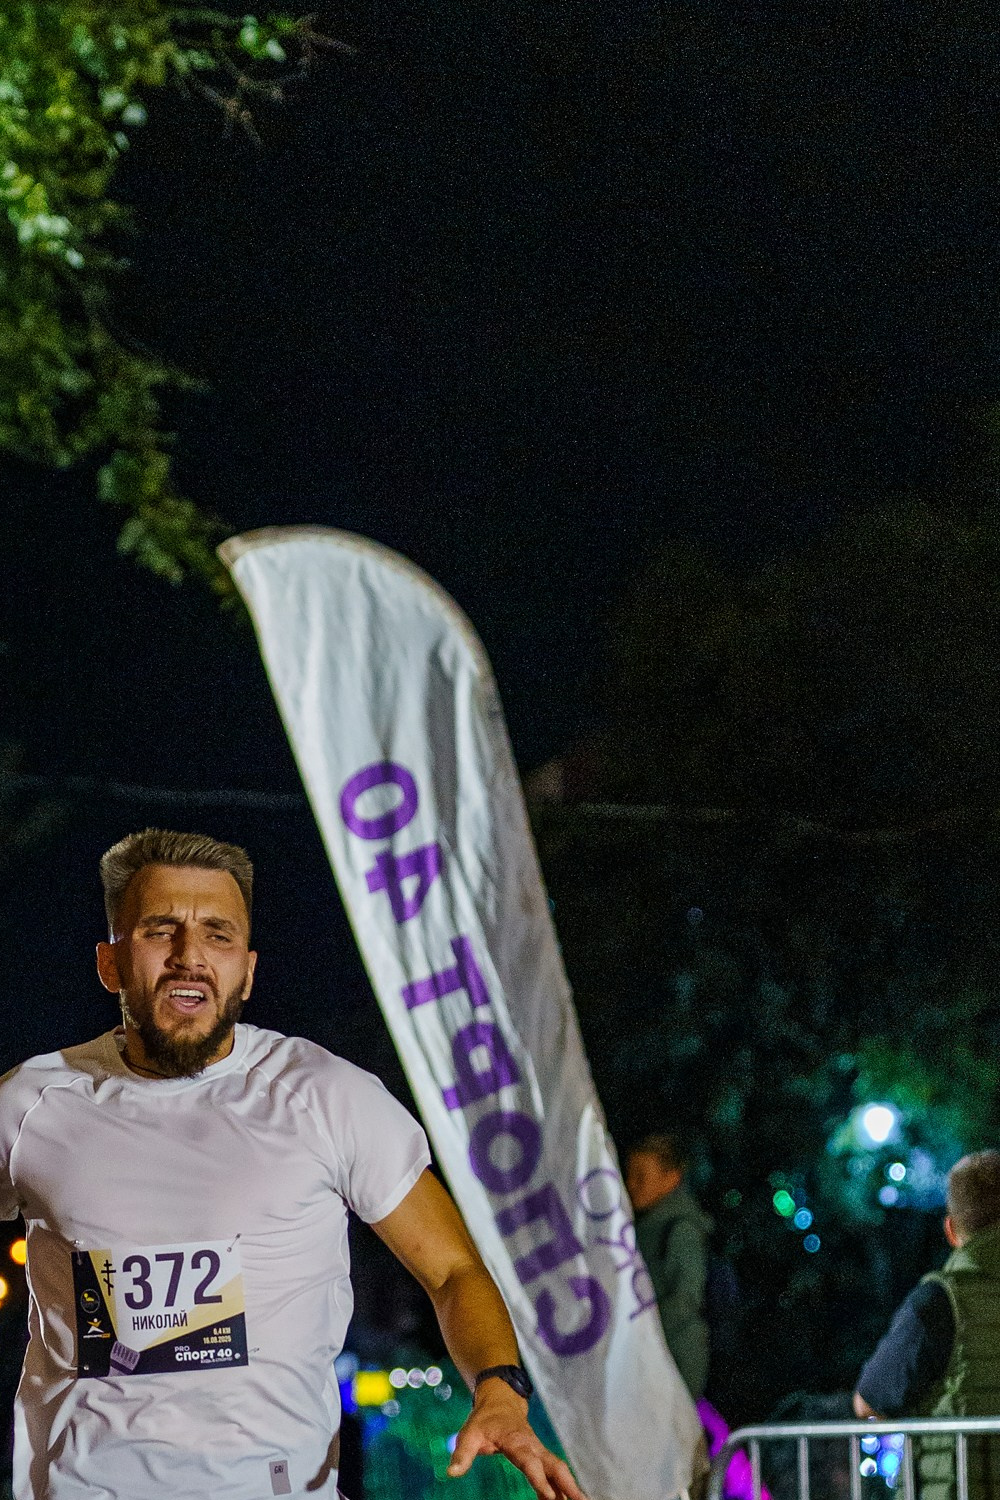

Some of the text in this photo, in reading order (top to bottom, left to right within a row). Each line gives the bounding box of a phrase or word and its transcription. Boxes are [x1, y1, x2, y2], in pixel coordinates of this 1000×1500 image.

[122, 1249, 223, 1310] 372
[132, 1309, 188, 1331] НИКОЛАЙ
[174, 1345, 191, 1353] PRO
[175, 1349, 216, 1362] СПОРТ
[217, 1347, 233, 1359] 40
